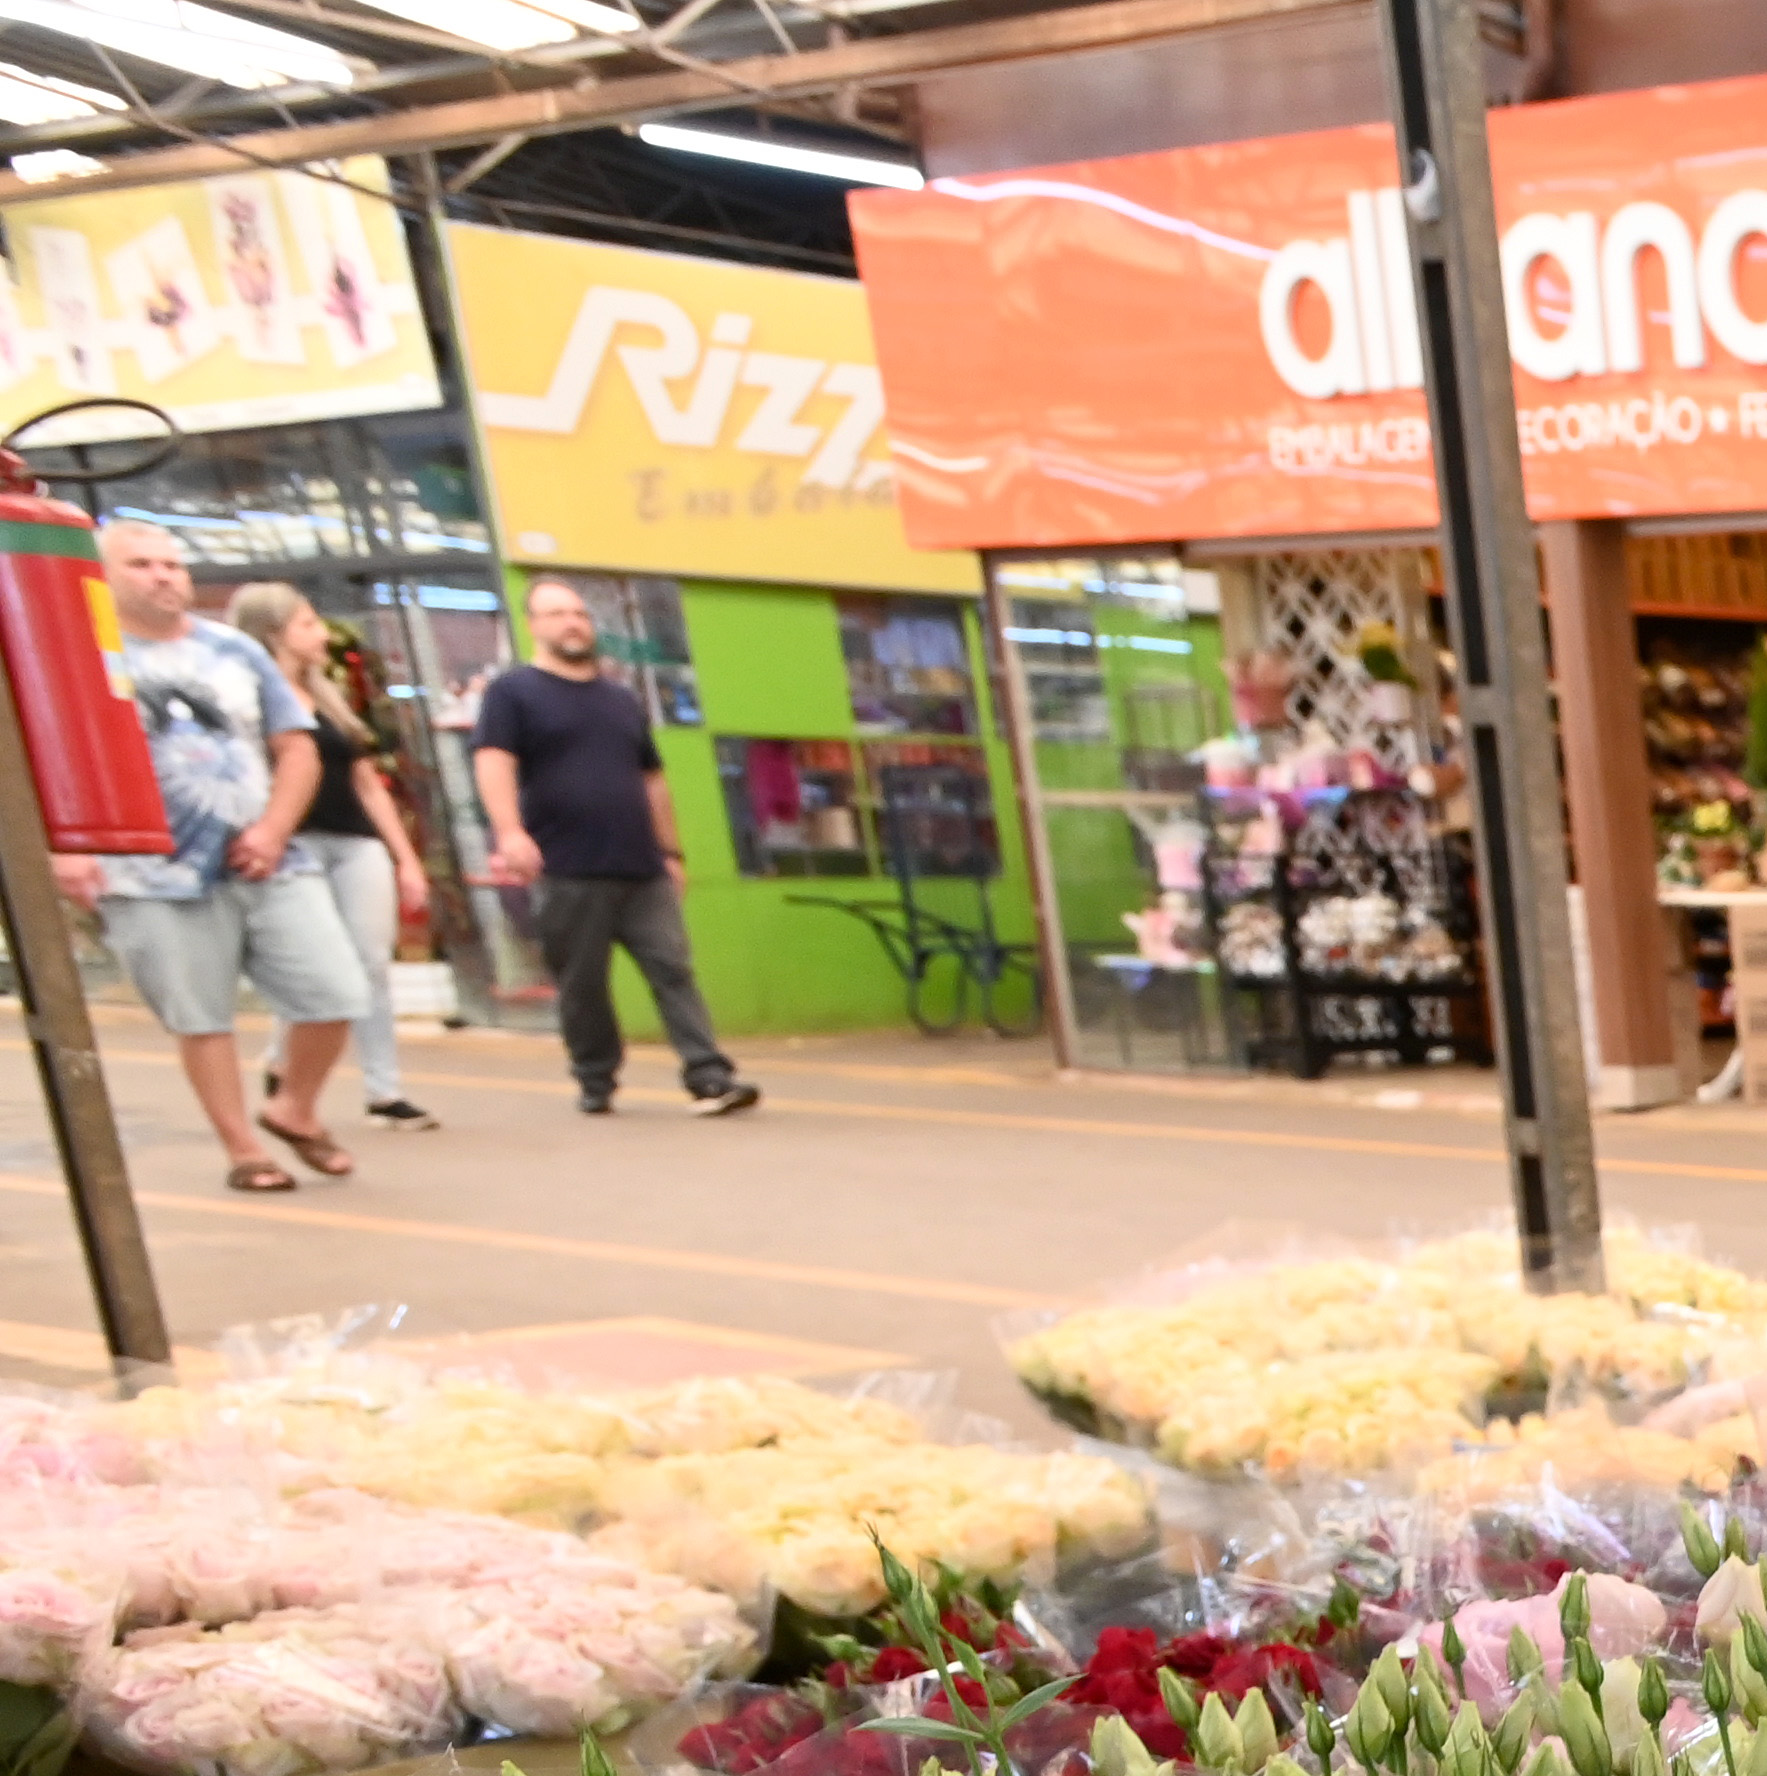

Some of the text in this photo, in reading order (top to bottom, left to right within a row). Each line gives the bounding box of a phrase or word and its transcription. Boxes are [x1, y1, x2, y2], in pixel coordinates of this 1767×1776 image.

[480, 284, 895, 490] Rizz
[1267, 415, 1432, 475] EMBALAGE
[1515, 389, 1703, 457] ECORAÇÃO
